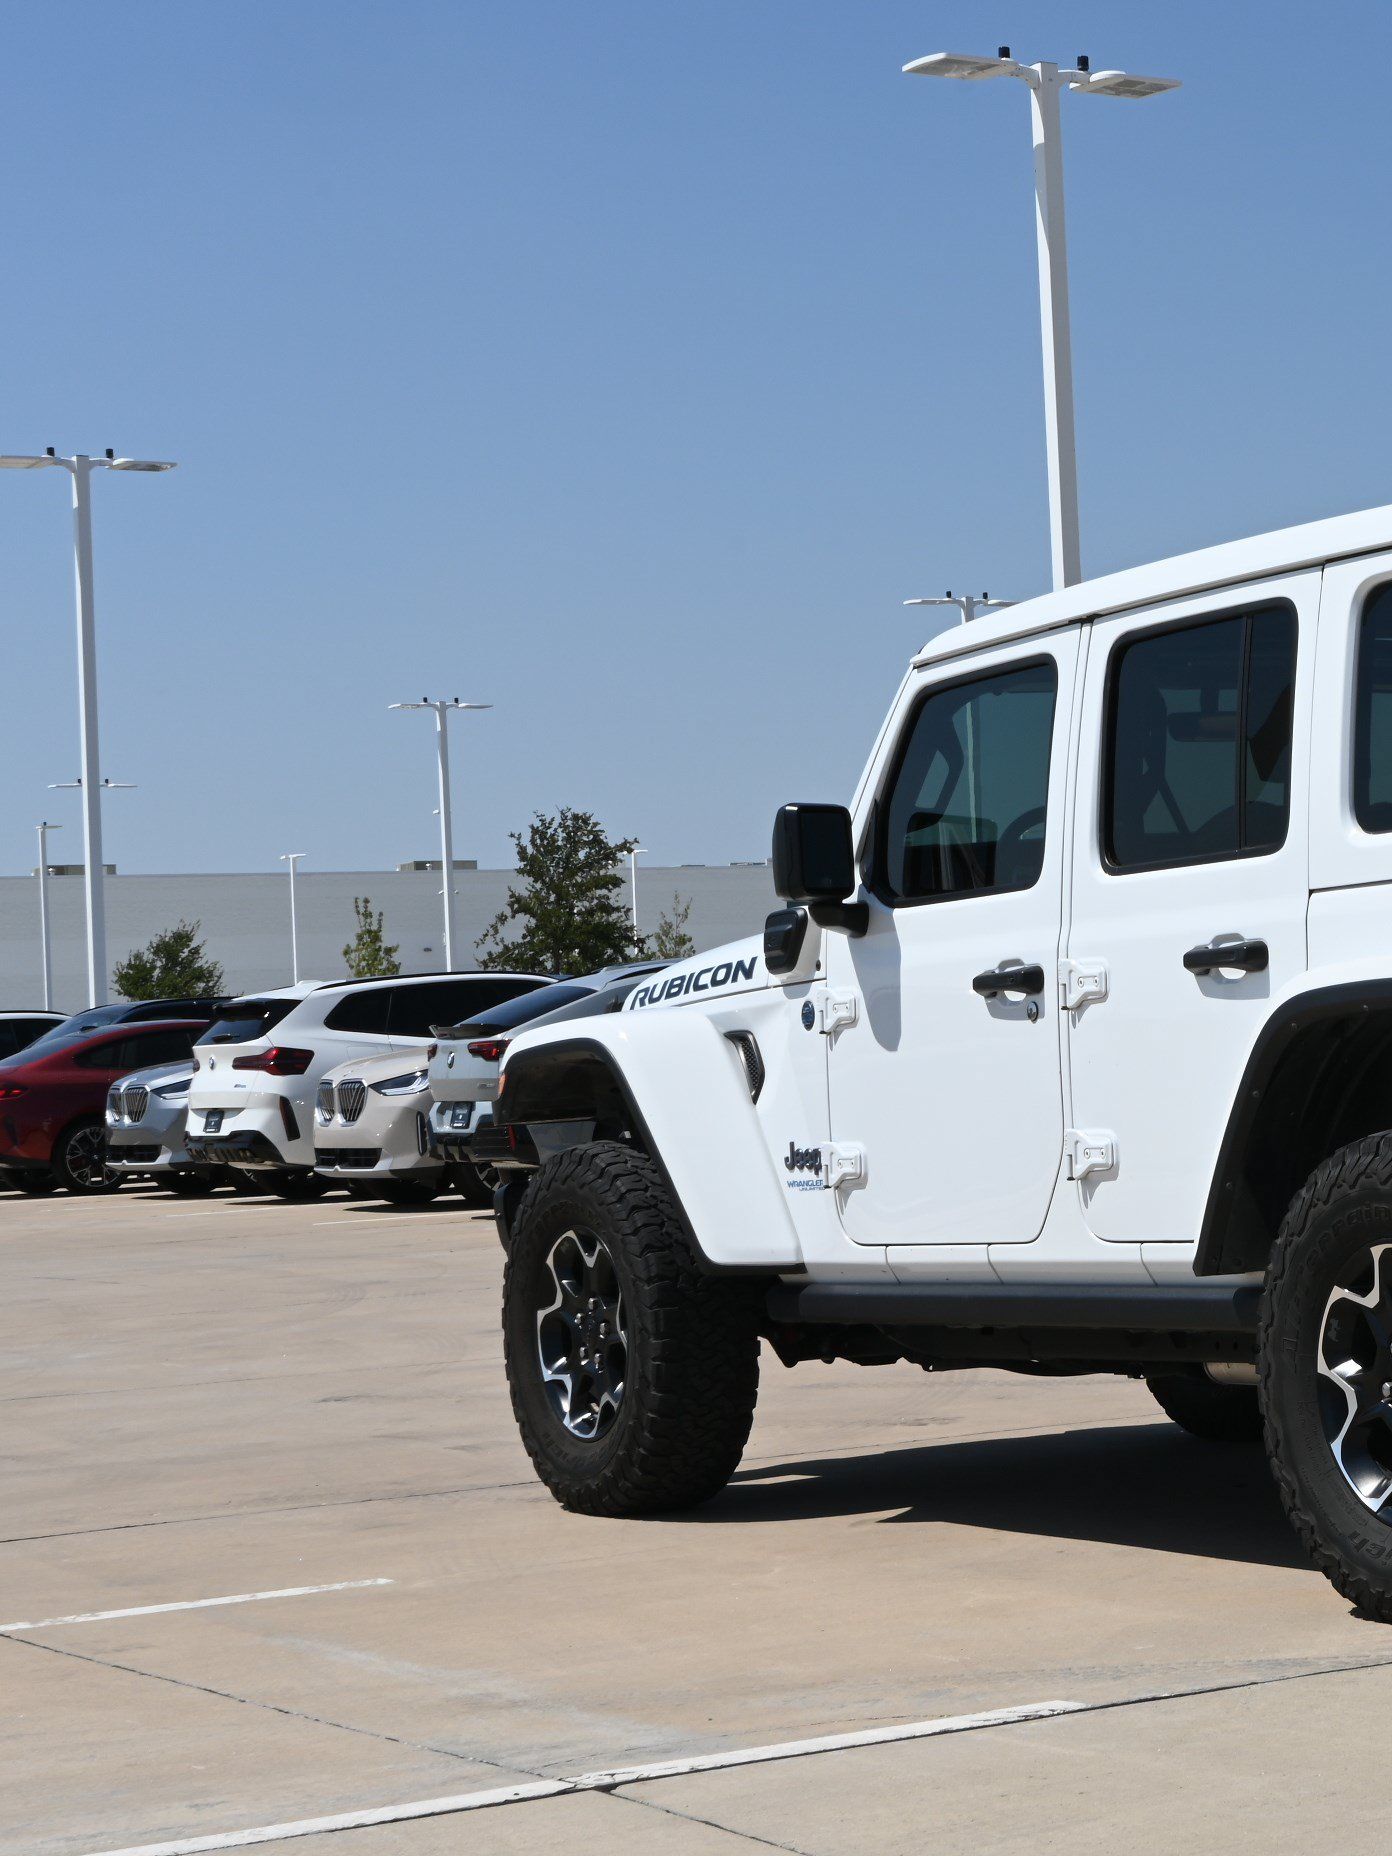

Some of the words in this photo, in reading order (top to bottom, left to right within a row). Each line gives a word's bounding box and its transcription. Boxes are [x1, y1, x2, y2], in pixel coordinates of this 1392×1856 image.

[629, 956, 758, 1011] RUBICON
[784, 1141, 822, 1176] Jeep
[787, 1180, 824, 1188] WRANGLER
